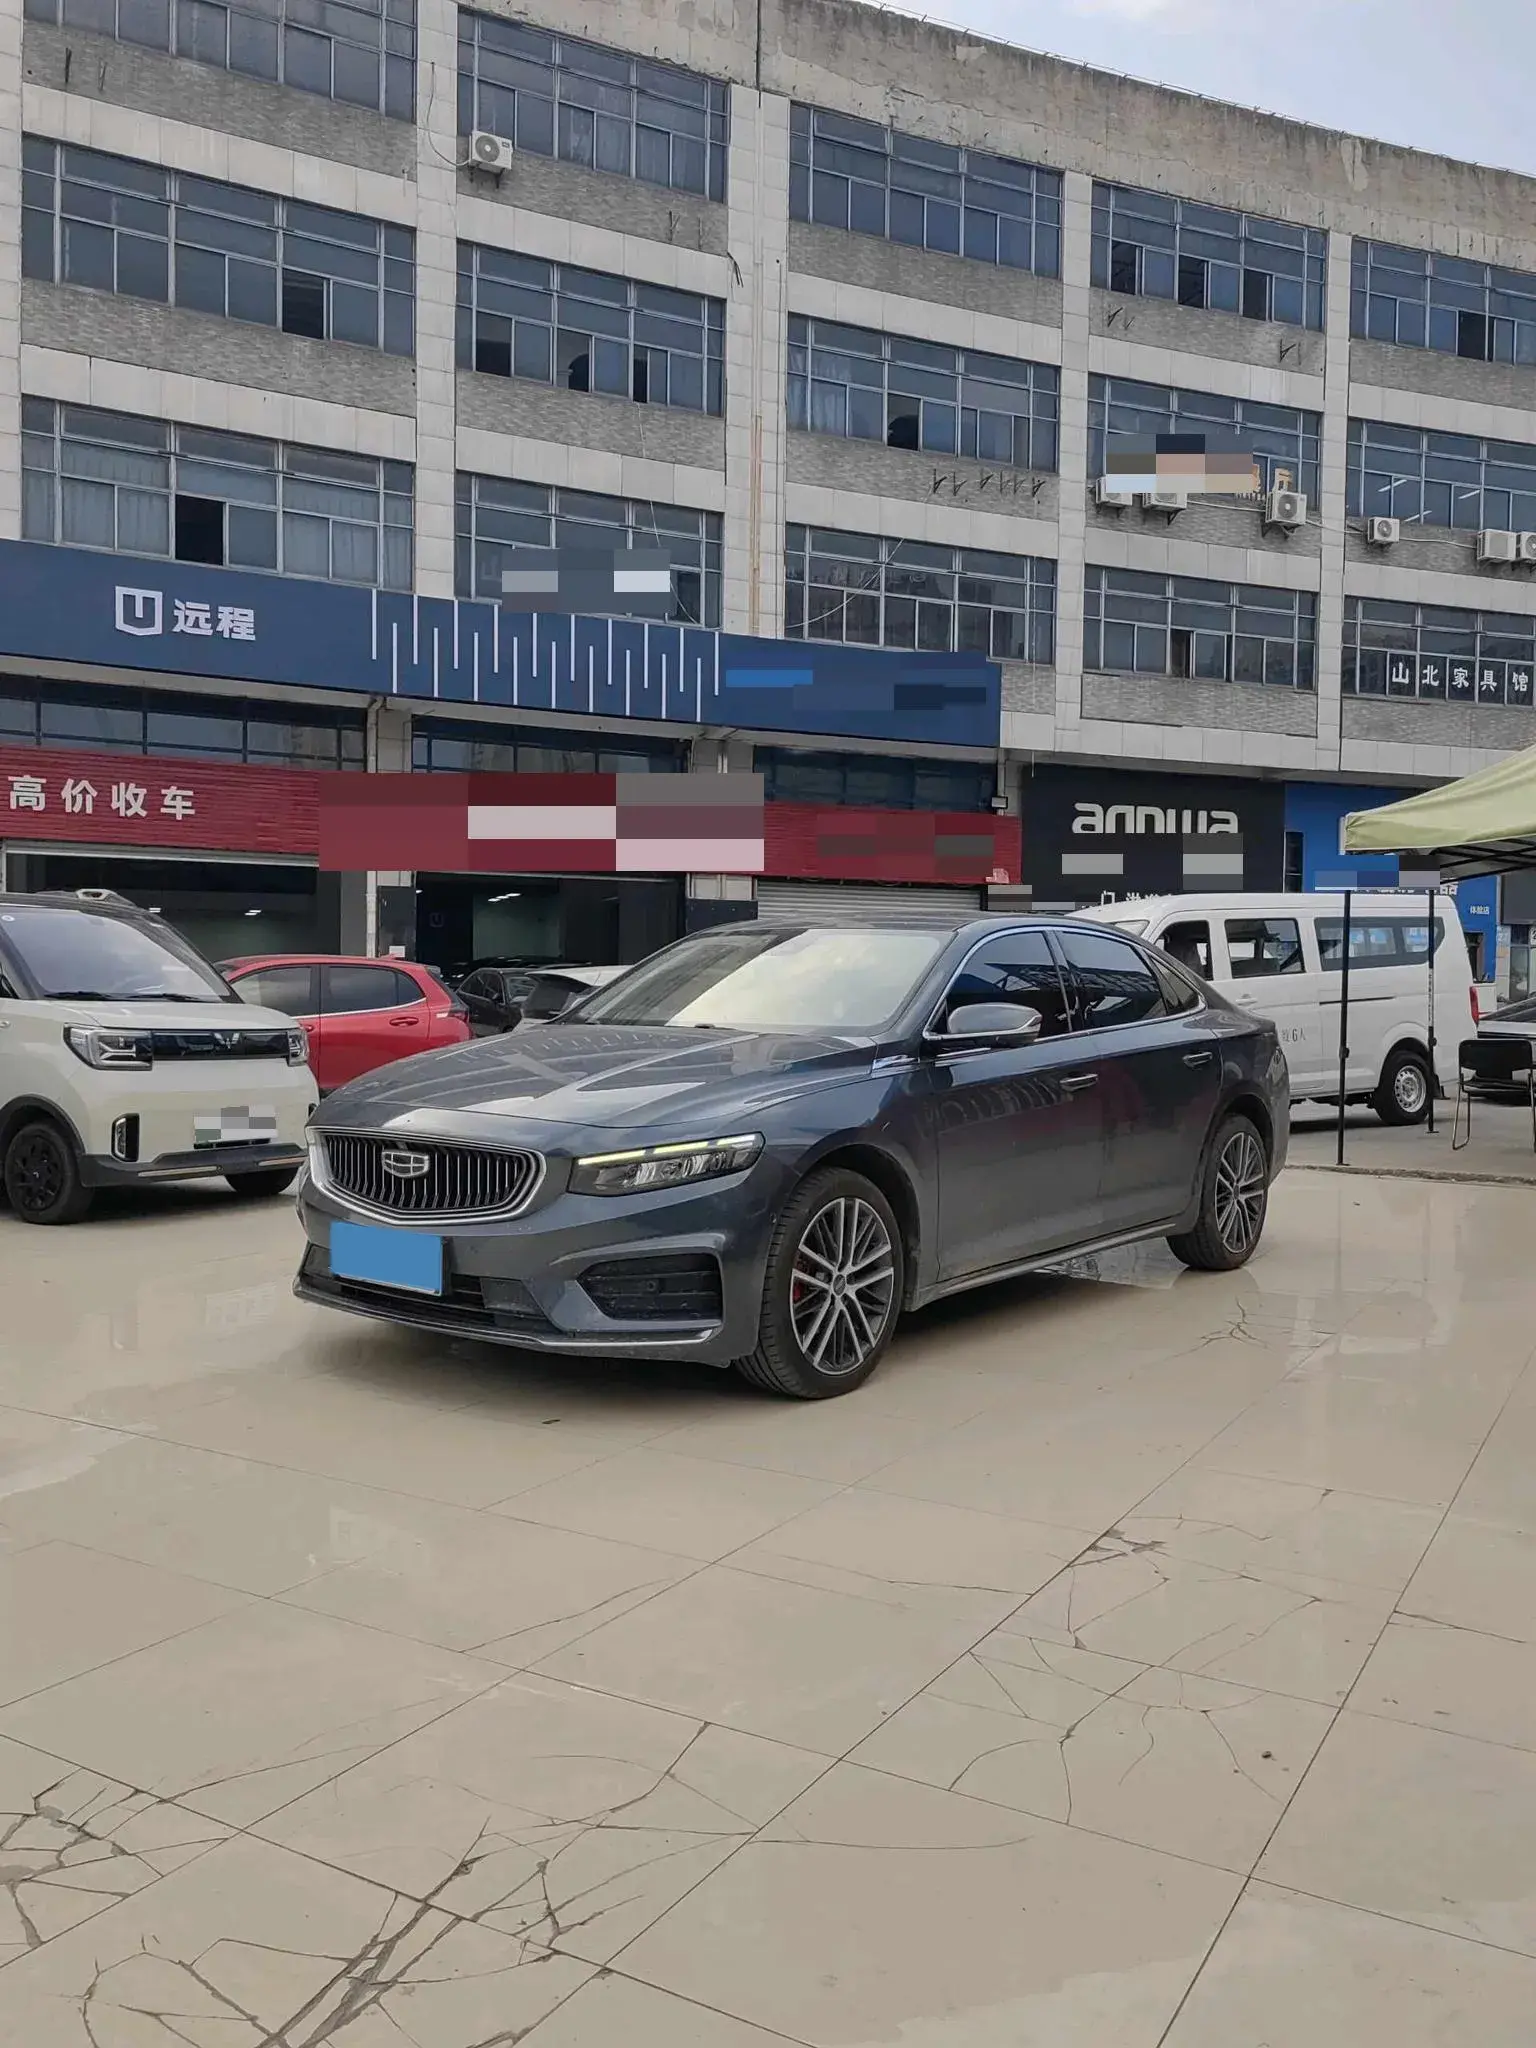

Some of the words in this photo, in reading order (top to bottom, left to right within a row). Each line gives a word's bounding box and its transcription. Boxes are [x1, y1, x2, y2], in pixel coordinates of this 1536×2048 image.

[172, 599, 256, 641] 远程
[1391, 661, 1529, 692] 山北家具馆
[7, 774, 196, 821] 高价收车
